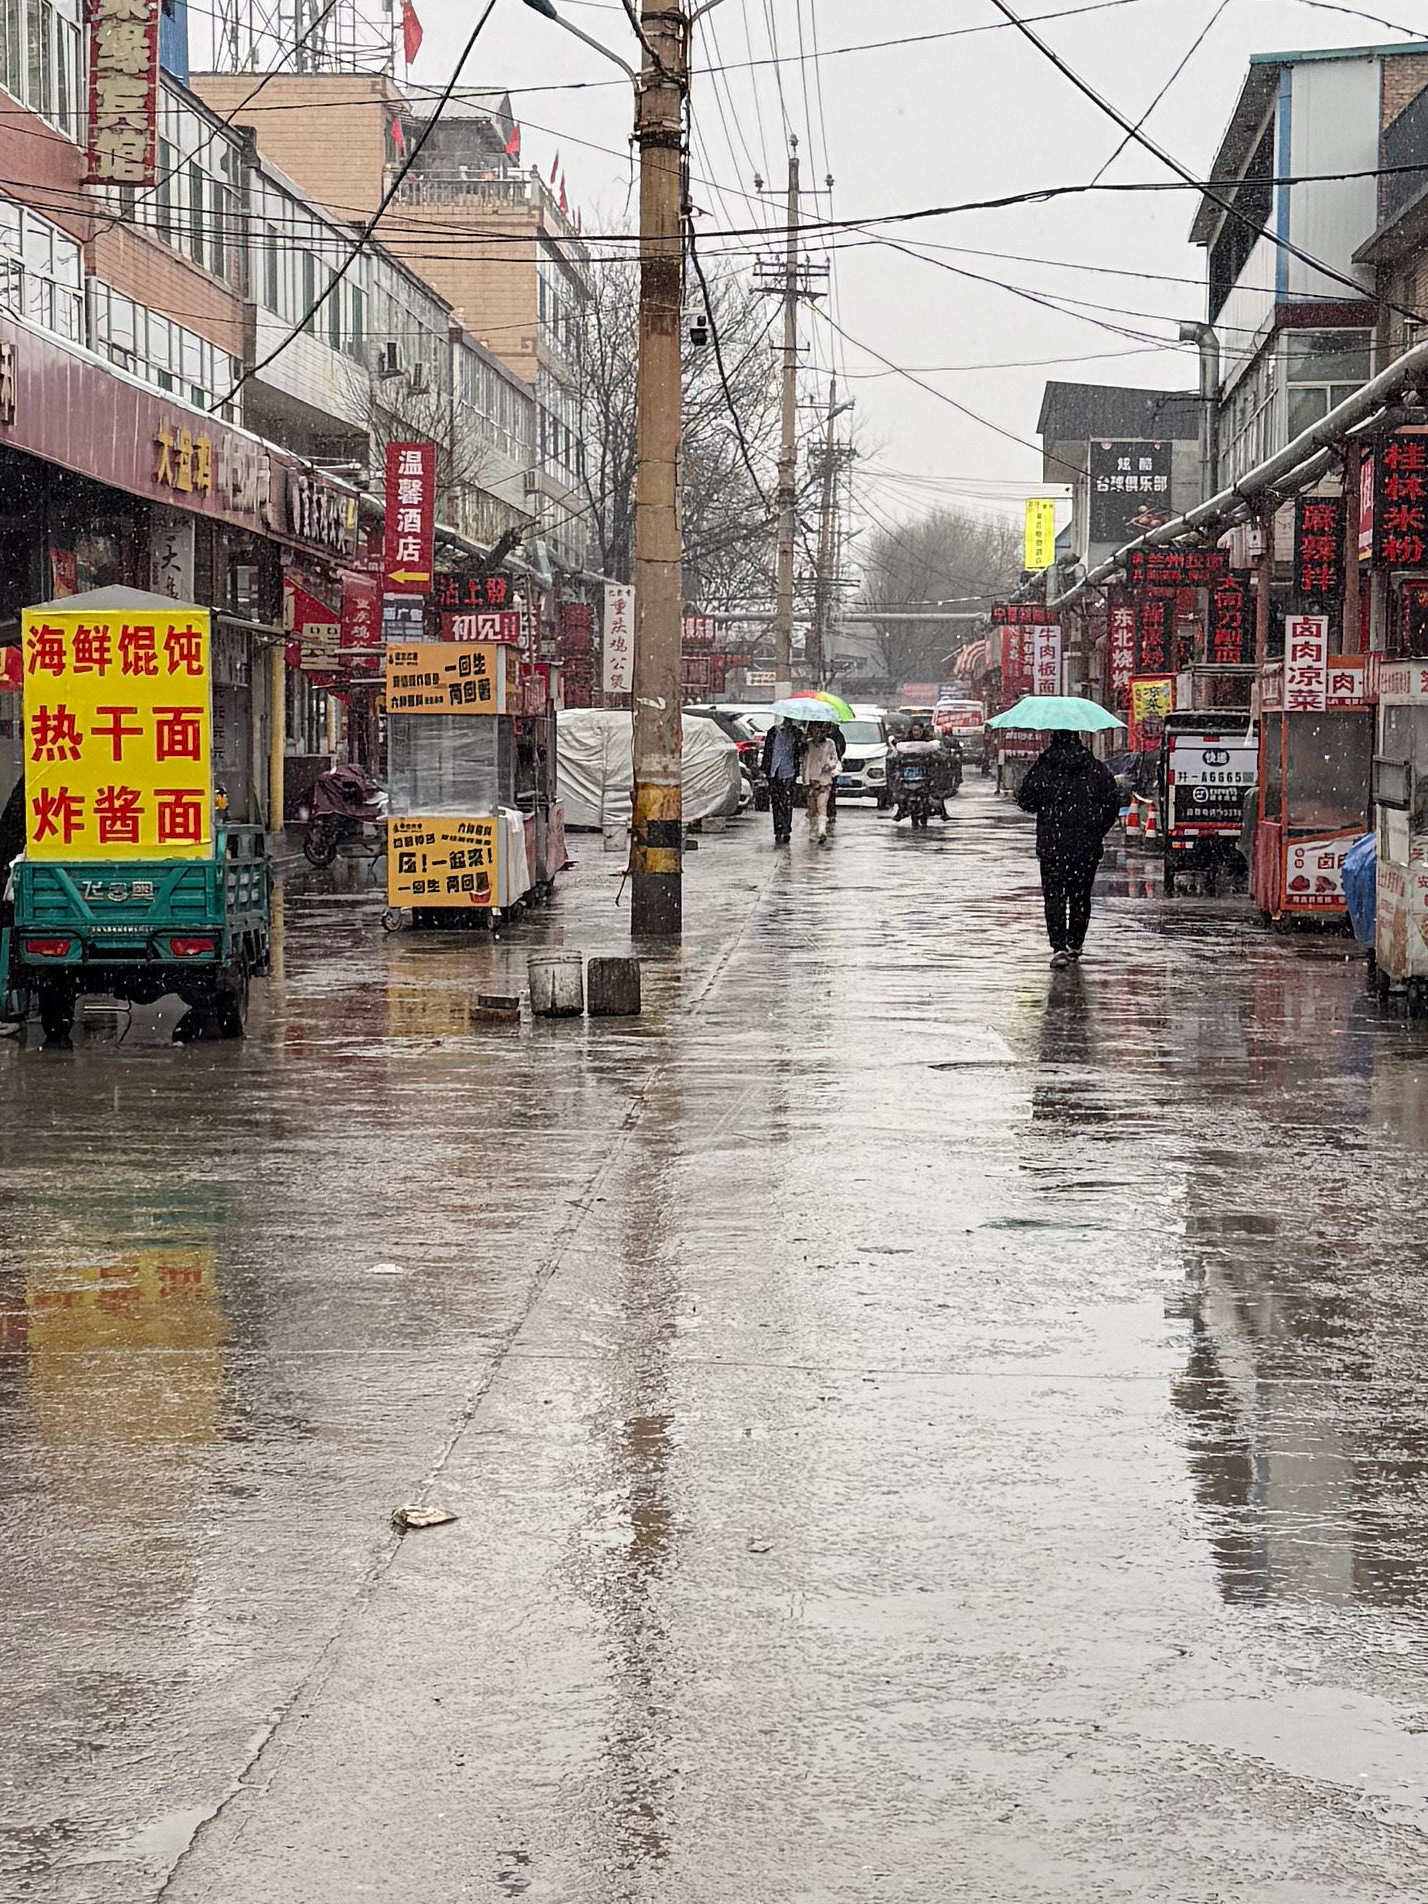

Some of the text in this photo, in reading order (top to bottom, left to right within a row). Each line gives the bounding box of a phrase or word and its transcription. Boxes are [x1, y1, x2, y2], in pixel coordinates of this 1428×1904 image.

[398, 450, 422, 563] 温馨酒店
[1097, 475, 1168, 492] 台球俱乐部
[1383, 442, 1426, 563] 桂林米粉
[26, 625, 205, 677] 海鲜馄饨
[452, 613, 501, 642] 初见
[1037, 627, 1058, 696] 牛肉板面
[1287, 617, 1324, 712] 卤肉凉菜
[30, 704, 205, 762] 热干面
[31, 785, 206, 844] 炸酱面
